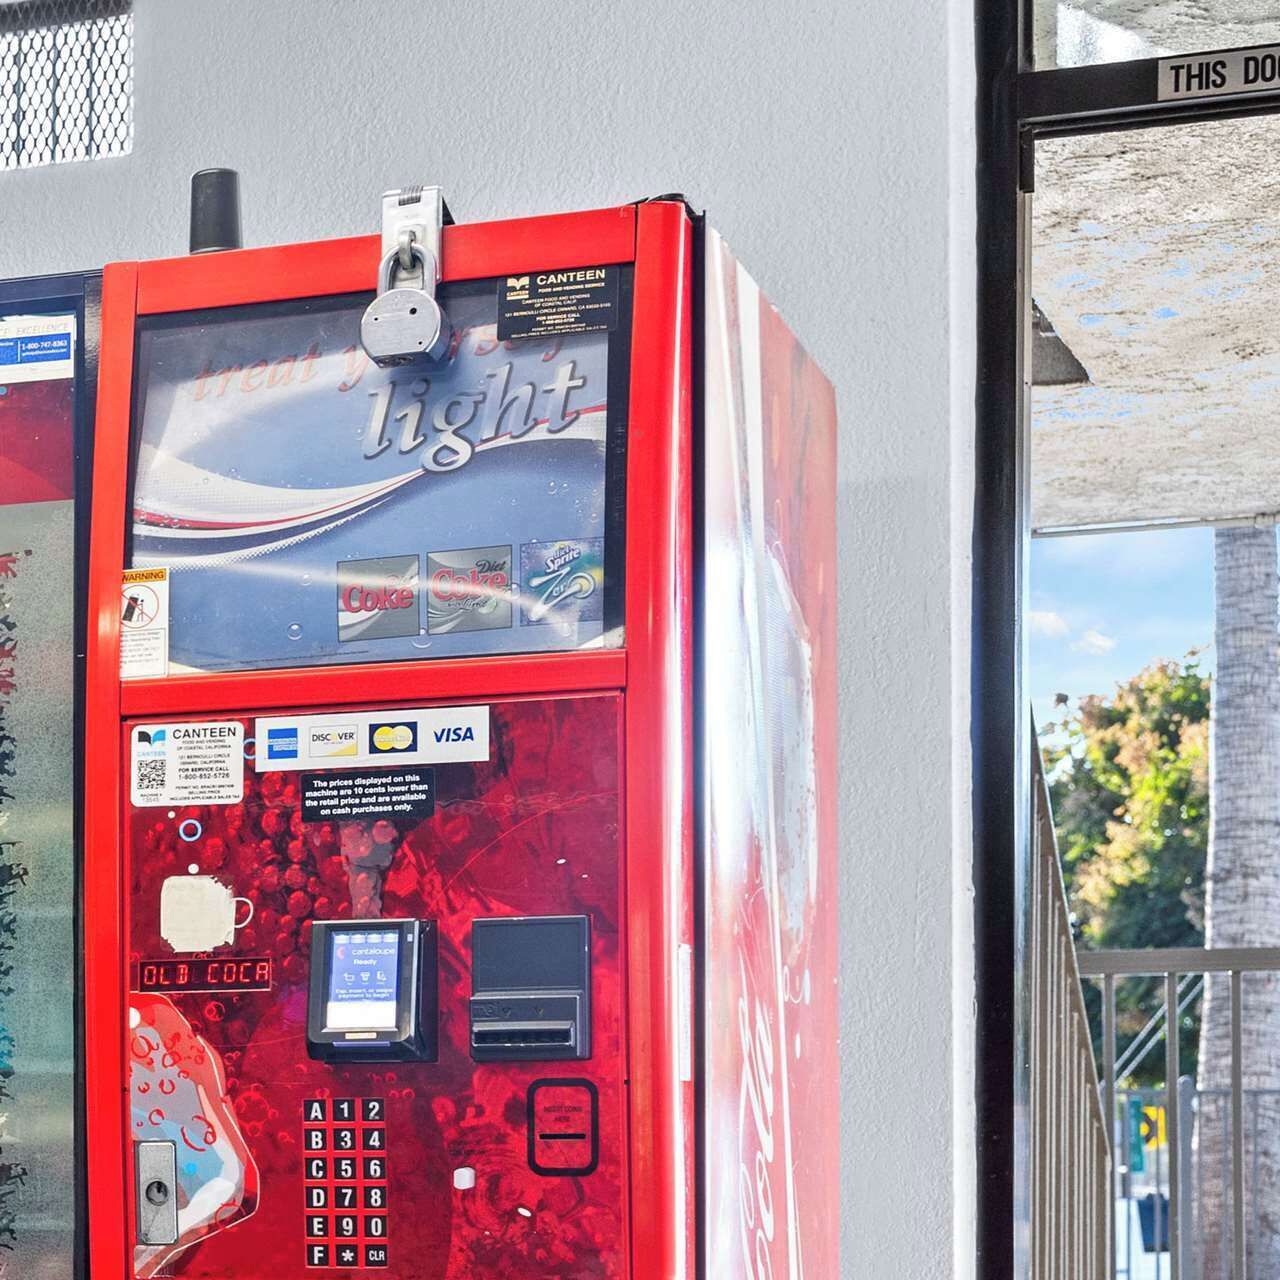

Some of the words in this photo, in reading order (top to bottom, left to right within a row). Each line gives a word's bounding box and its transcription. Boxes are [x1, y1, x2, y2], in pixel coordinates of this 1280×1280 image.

[1170, 60, 1227, 93] THIS
[1243, 54, 1280, 85] DO
[537, 269, 605, 284] CANTEEN
[193, 342, 323, 400] treat
[363, 361, 587, 472] light
[476, 560, 506, 573] Diet
[545, 548, 579, 573] Sprite
[431, 569, 508, 600] Coke
[342, 584, 413, 613] Coke
[173, 727, 236, 739] CANTEEN
[433, 727, 474, 743] VISA
[306, 789, 337, 798] machine
[364, 786, 385, 794] cents
[411, 783, 428, 791] than
[329, 779, 352, 788] prices
[354, 776, 391, 787] displayed
[320, 798, 338, 806] retail
[340, 797, 359, 806] price
[361, 796, 375, 804] and
[392, 793, 426, 802] available
[332, 807, 350, 815] cash
[353, 805, 392, 815] purchases
[394, 804, 412, 813] only.
[144, 965, 188, 984] OLD
[208, 963, 268, 982] COCA
[310, 1103, 322, 1120] A
[340, 1102, 348, 1117] 1
[368, 1102, 379, 1120] 2
[312, 1131, 322, 1149] B
[341, 1131, 351, 1148] 3
[369, 1131, 380, 1148] 4
[312, 1160, 323, 1177] C
[342, 1160, 351, 1177] 5
[370, 1160, 380, 1177] 6
[313, 1189, 324, 1206] D
[342, 1189, 352, 1206] 7
[371, 1189, 381, 1206] 8
[313, 1218, 323, 1235] E
[342, 1218, 352, 1236] 9
[371, 1218, 381, 1236] 0
[314, 1247, 323, 1264] F
[369, 1251, 384, 1260] CLR
